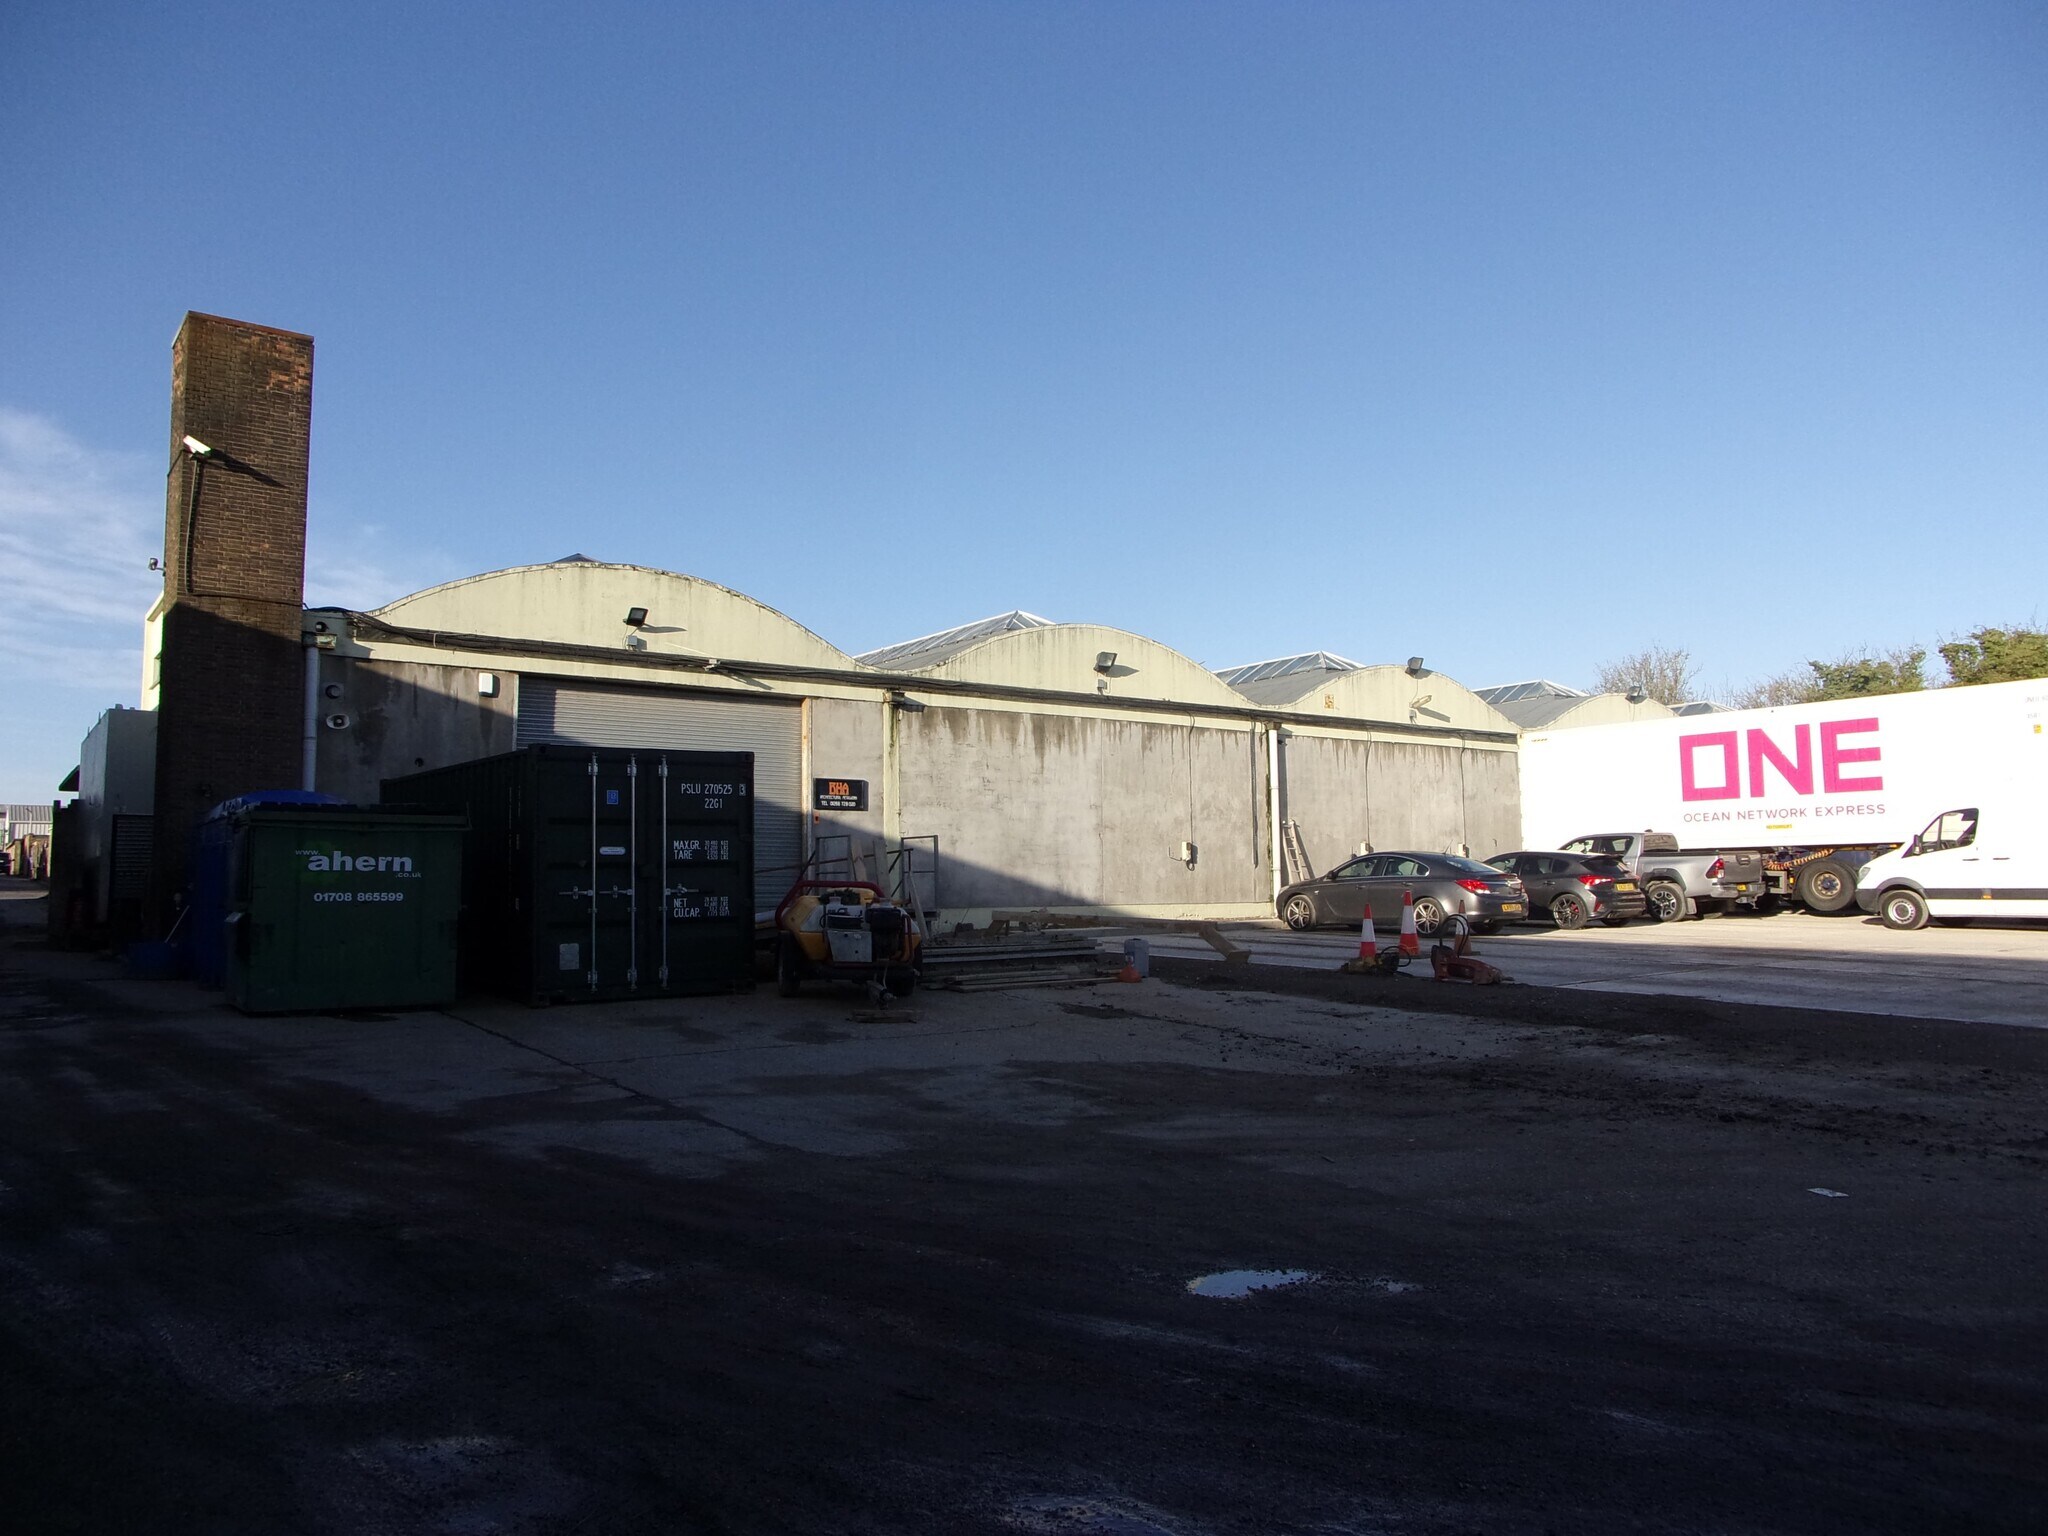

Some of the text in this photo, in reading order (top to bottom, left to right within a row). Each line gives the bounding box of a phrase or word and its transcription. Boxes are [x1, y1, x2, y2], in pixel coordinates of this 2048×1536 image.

[1679, 717, 1883, 802] ONE
[681, 783, 701, 794] PSLU
[704, 783, 733, 795] 270525
[704, 798, 723, 809] 22G1
[1683, 804, 1886, 823] OCEAN NETWORK EXPRESS
[307, 850, 413, 871] ahern
[673, 850, 693, 860] TARE
[313, 892, 404, 902] 01708 865599
[673, 897, 688, 908] NET
